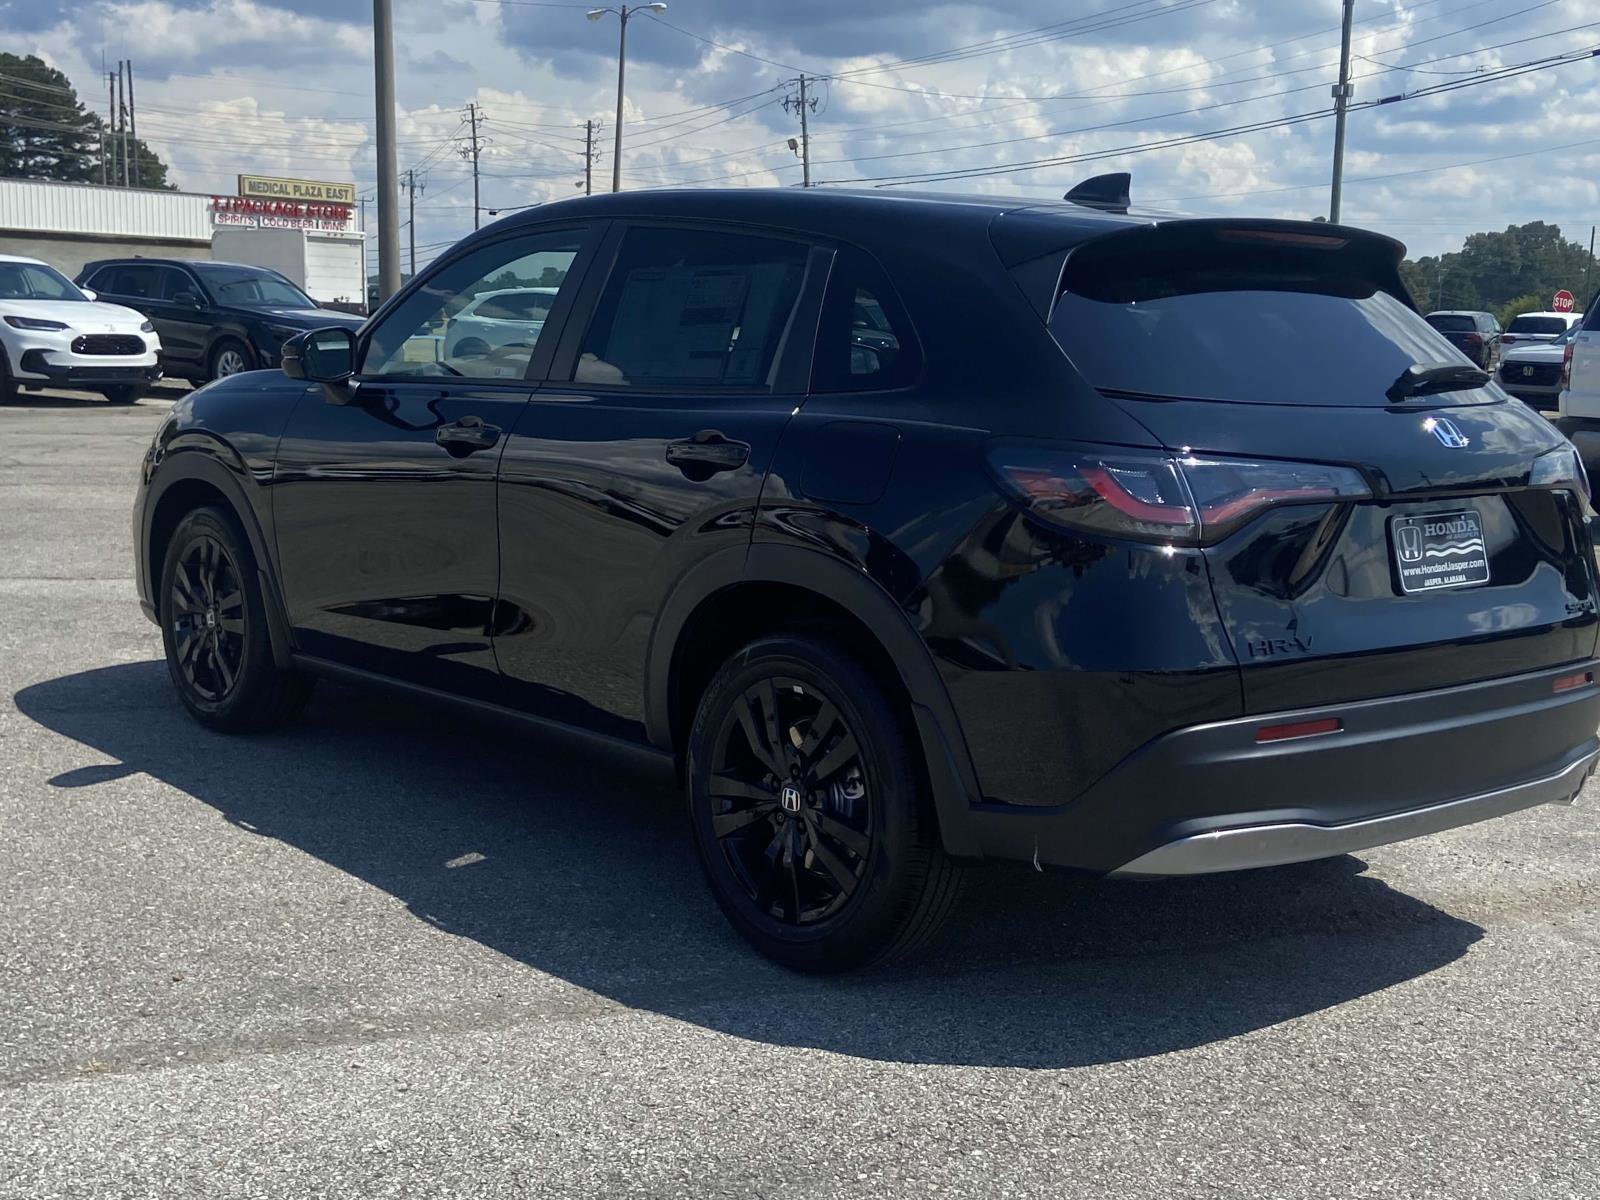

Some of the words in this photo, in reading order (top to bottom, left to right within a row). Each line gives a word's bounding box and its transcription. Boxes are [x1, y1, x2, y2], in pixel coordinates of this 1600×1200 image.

[248, 181, 290, 195] MEDICAL
[293, 185, 323, 198] PLAZA
[326, 188, 349, 200] EAST
[233, 198, 305, 217] PACKAGE
[306, 203, 353, 220] STORE
[218, 213, 254, 225] SPIRITS
[262, 217, 290, 228] COLD
[291, 219, 313, 229] BEER
[321, 221, 345, 231] WINE
[1554, 297, 1572, 308] STOP
[1424, 520, 1479, 536] HONDA
[1403, 560, 1485, 577] www.HondaofJasper.com
[1444, 574, 1466, 584] ALABAMA
